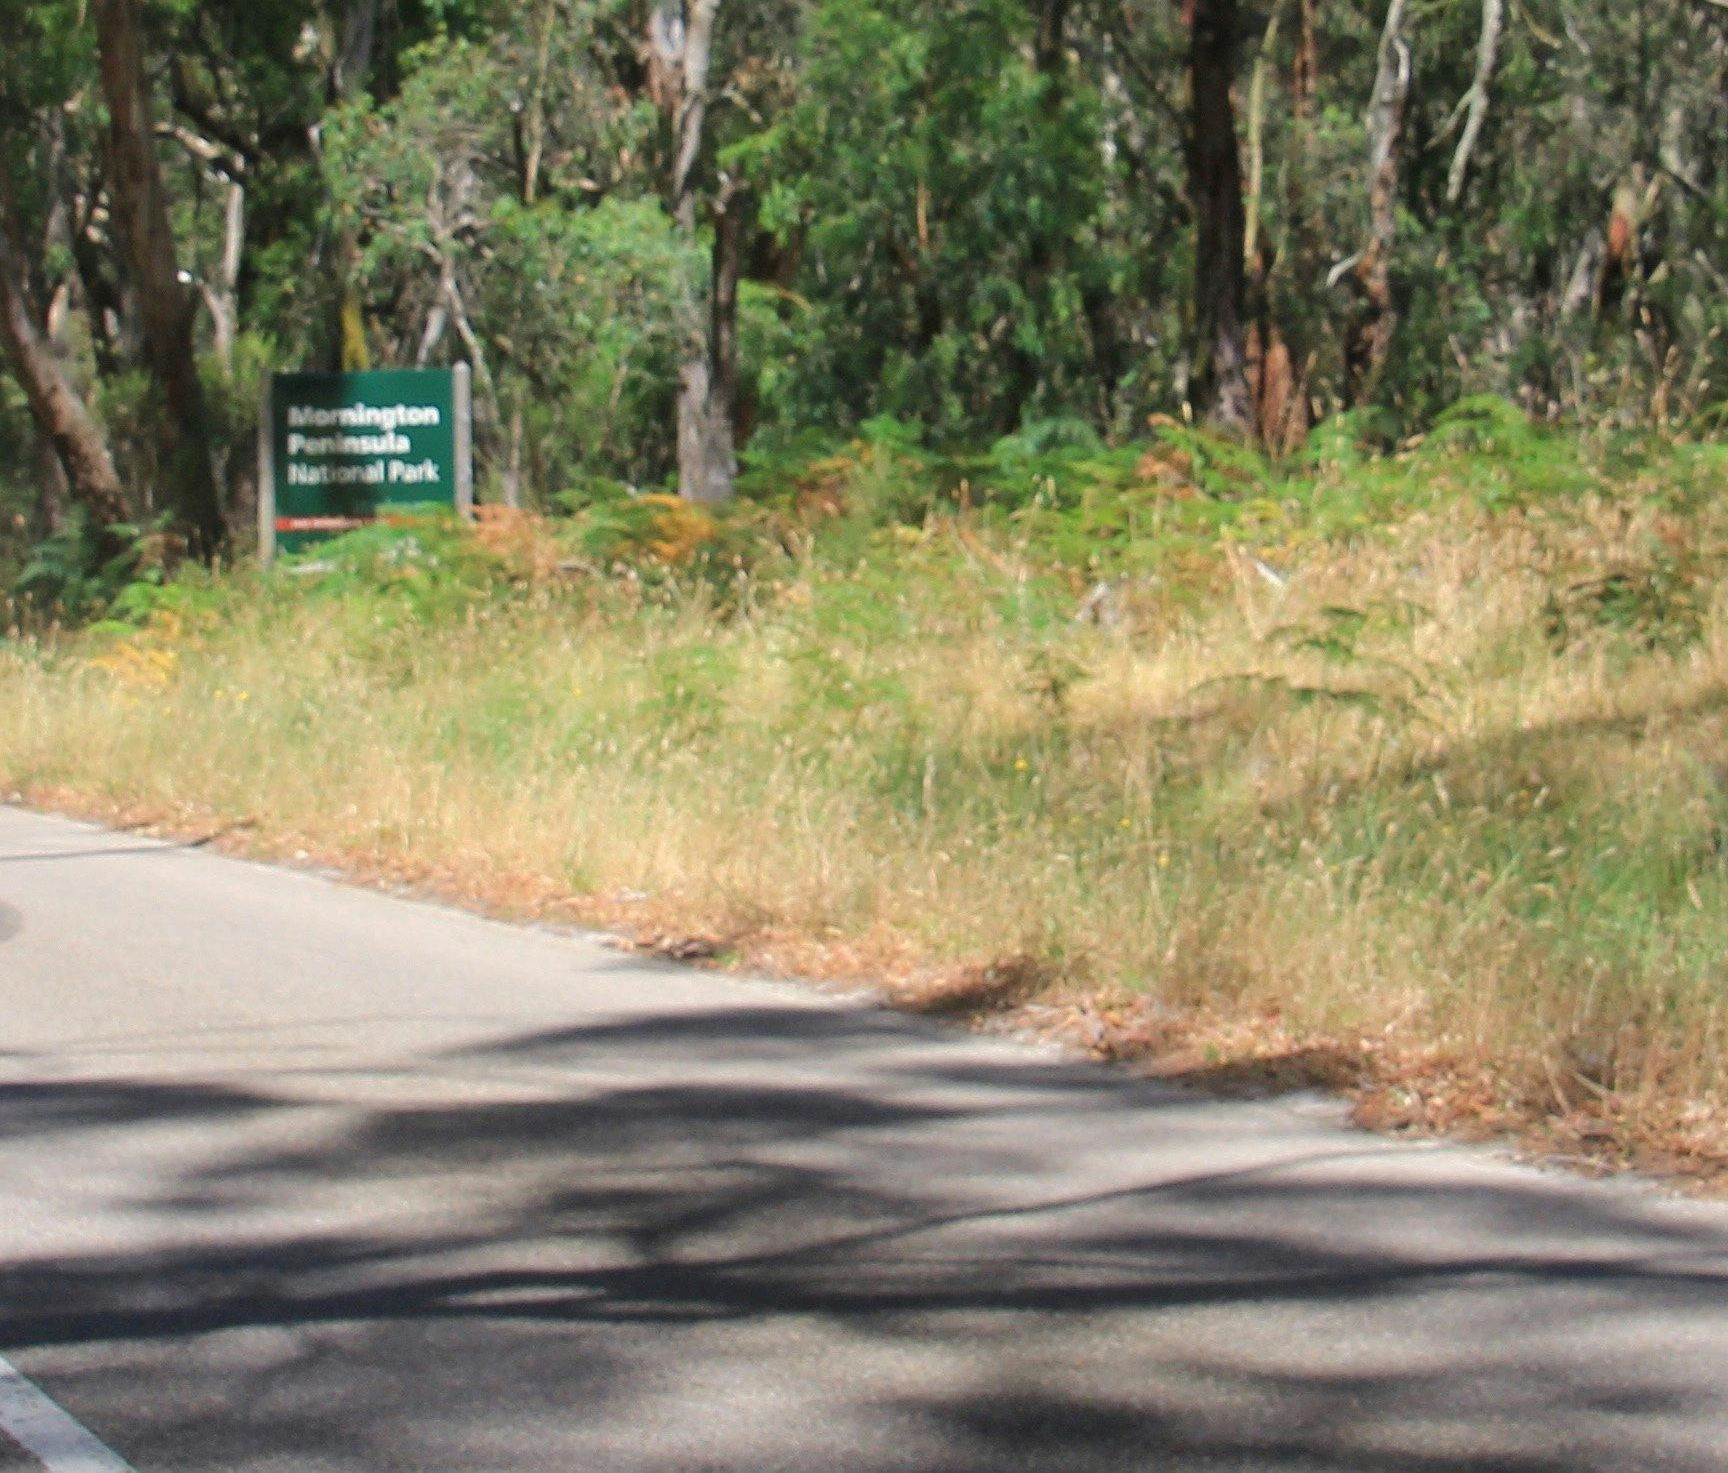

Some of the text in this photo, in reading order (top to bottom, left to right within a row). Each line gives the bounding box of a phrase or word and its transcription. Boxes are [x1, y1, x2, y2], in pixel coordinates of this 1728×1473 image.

[287, 402, 440, 431] Mornington
[287, 431, 411, 455] Peninsula
[287, 458, 440, 484] National Park
